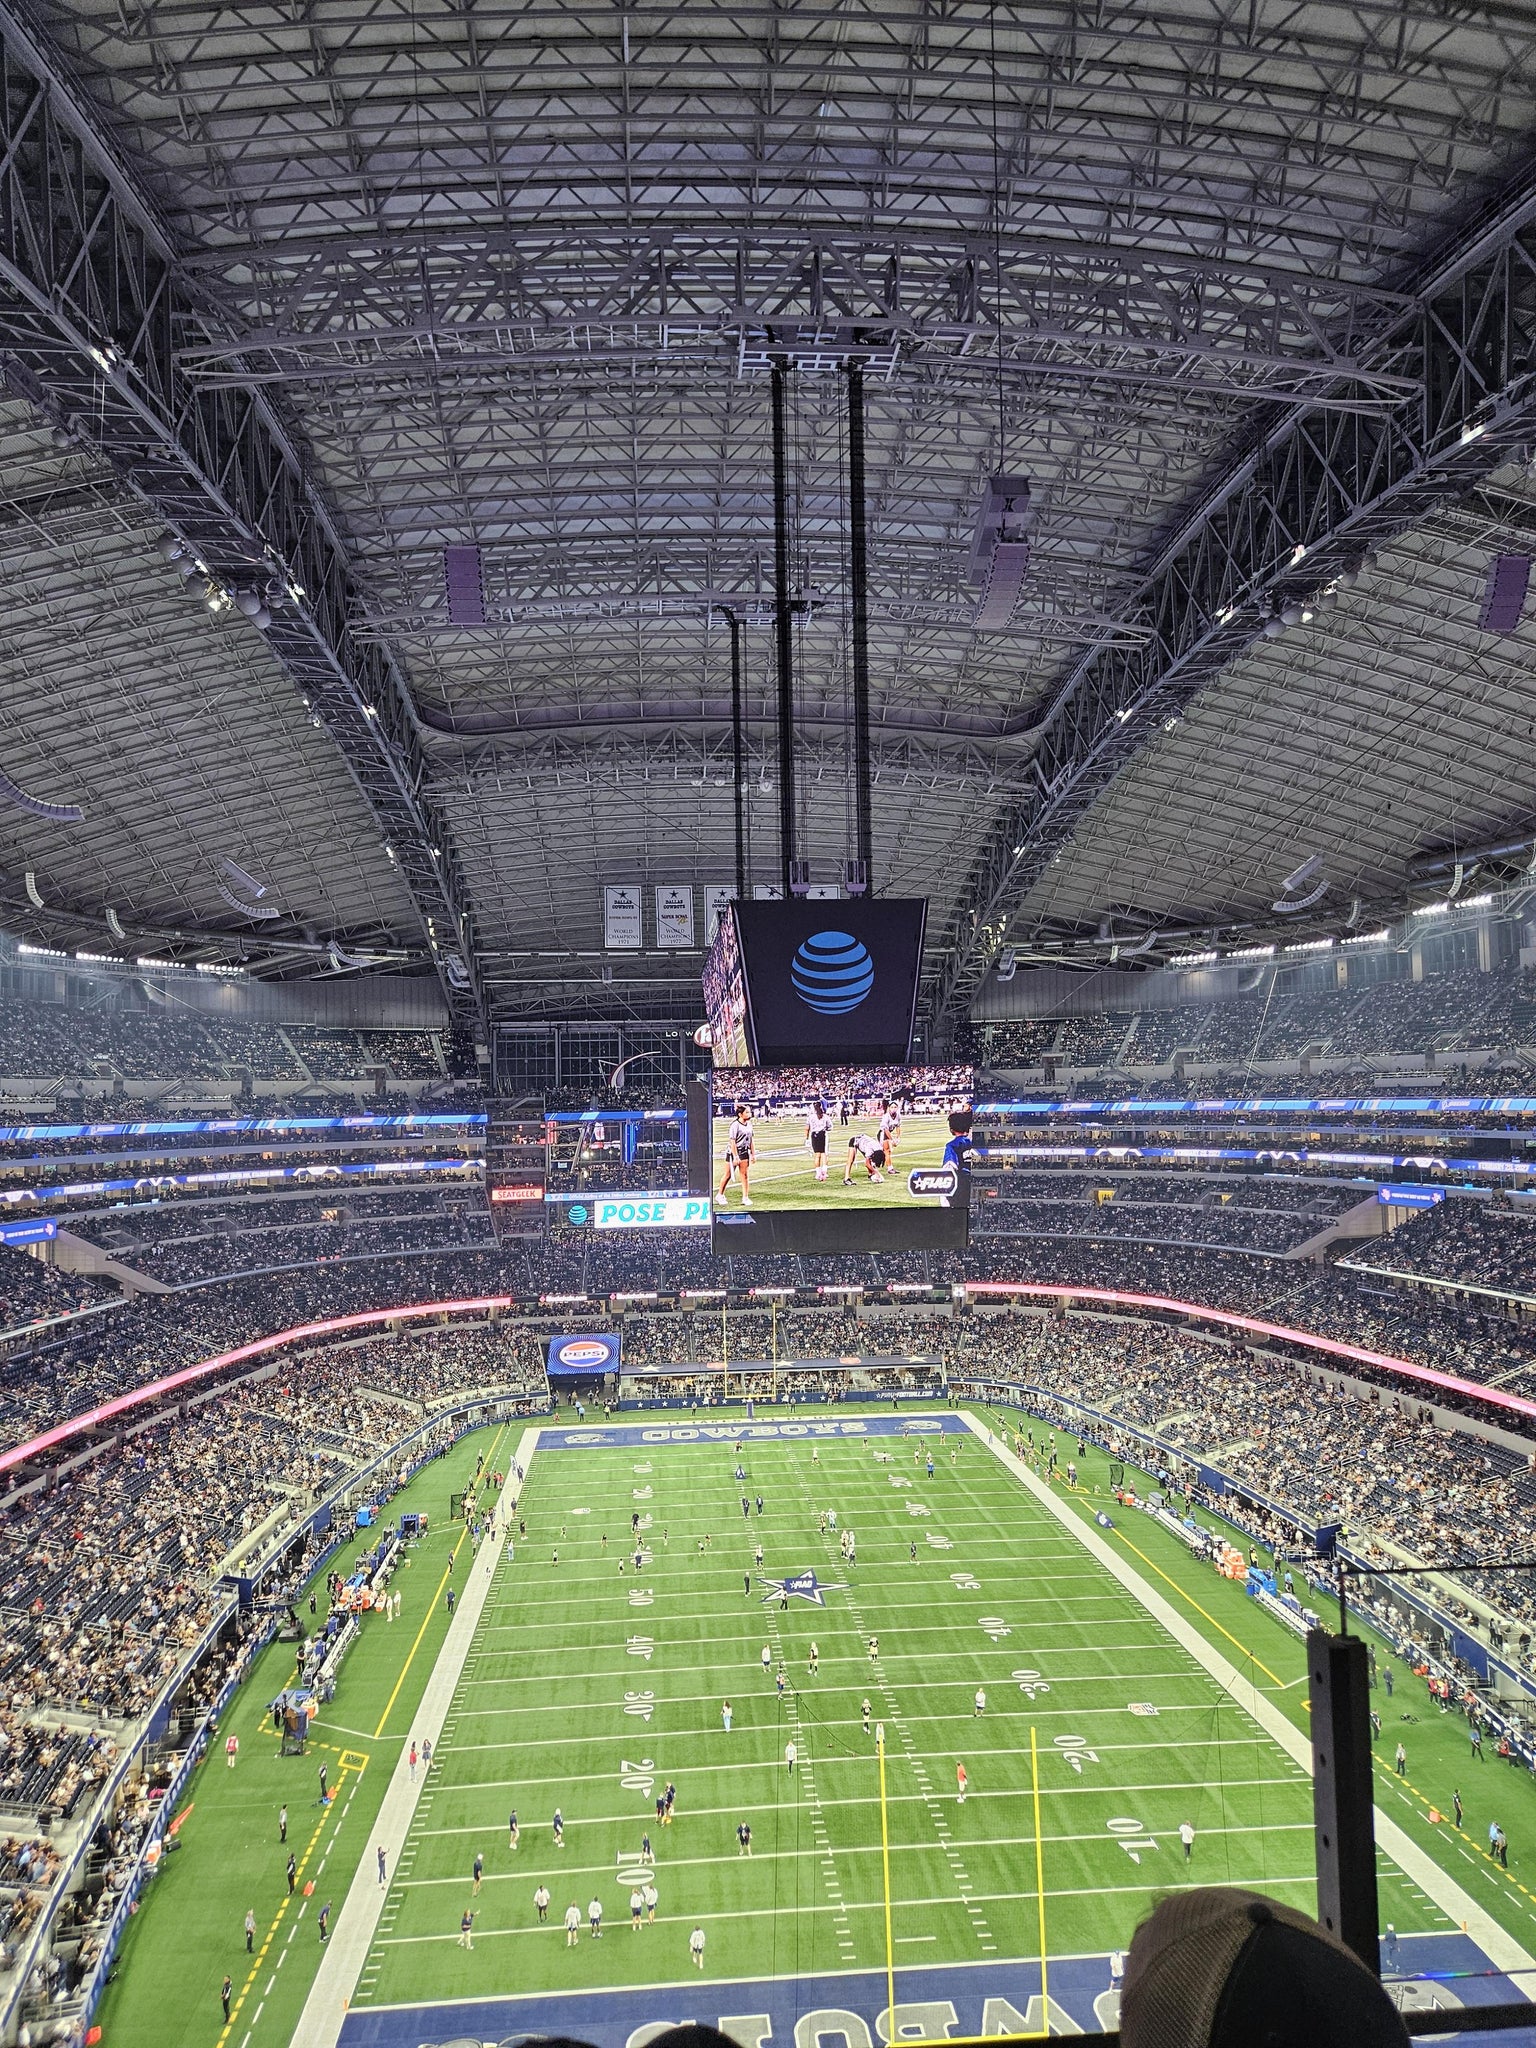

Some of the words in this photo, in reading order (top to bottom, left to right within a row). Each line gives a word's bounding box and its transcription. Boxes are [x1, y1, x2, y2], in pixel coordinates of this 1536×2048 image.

[498, 1190, 536, 1198] SEATGEEK
[600, 1204, 666, 1222] POSE
[642, 1422, 868, 1441] COWBOYS
[926, 1536, 954, 1550] 40
[950, 1573, 982, 1590] 50
[628, 1588, 654, 1606] 50
[978, 1617, 1012, 1636] 40
[626, 1635, 654, 1655] 40
[1011, 1669, 1050, 1692] 30
[624, 1690, 654, 1715] 30
[1053, 1734, 1100, 1762] 20
[620, 1758, 654, 1790] 20
[1106, 1818, 1160, 1851] 10
[616, 1850, 656, 1886] 10
